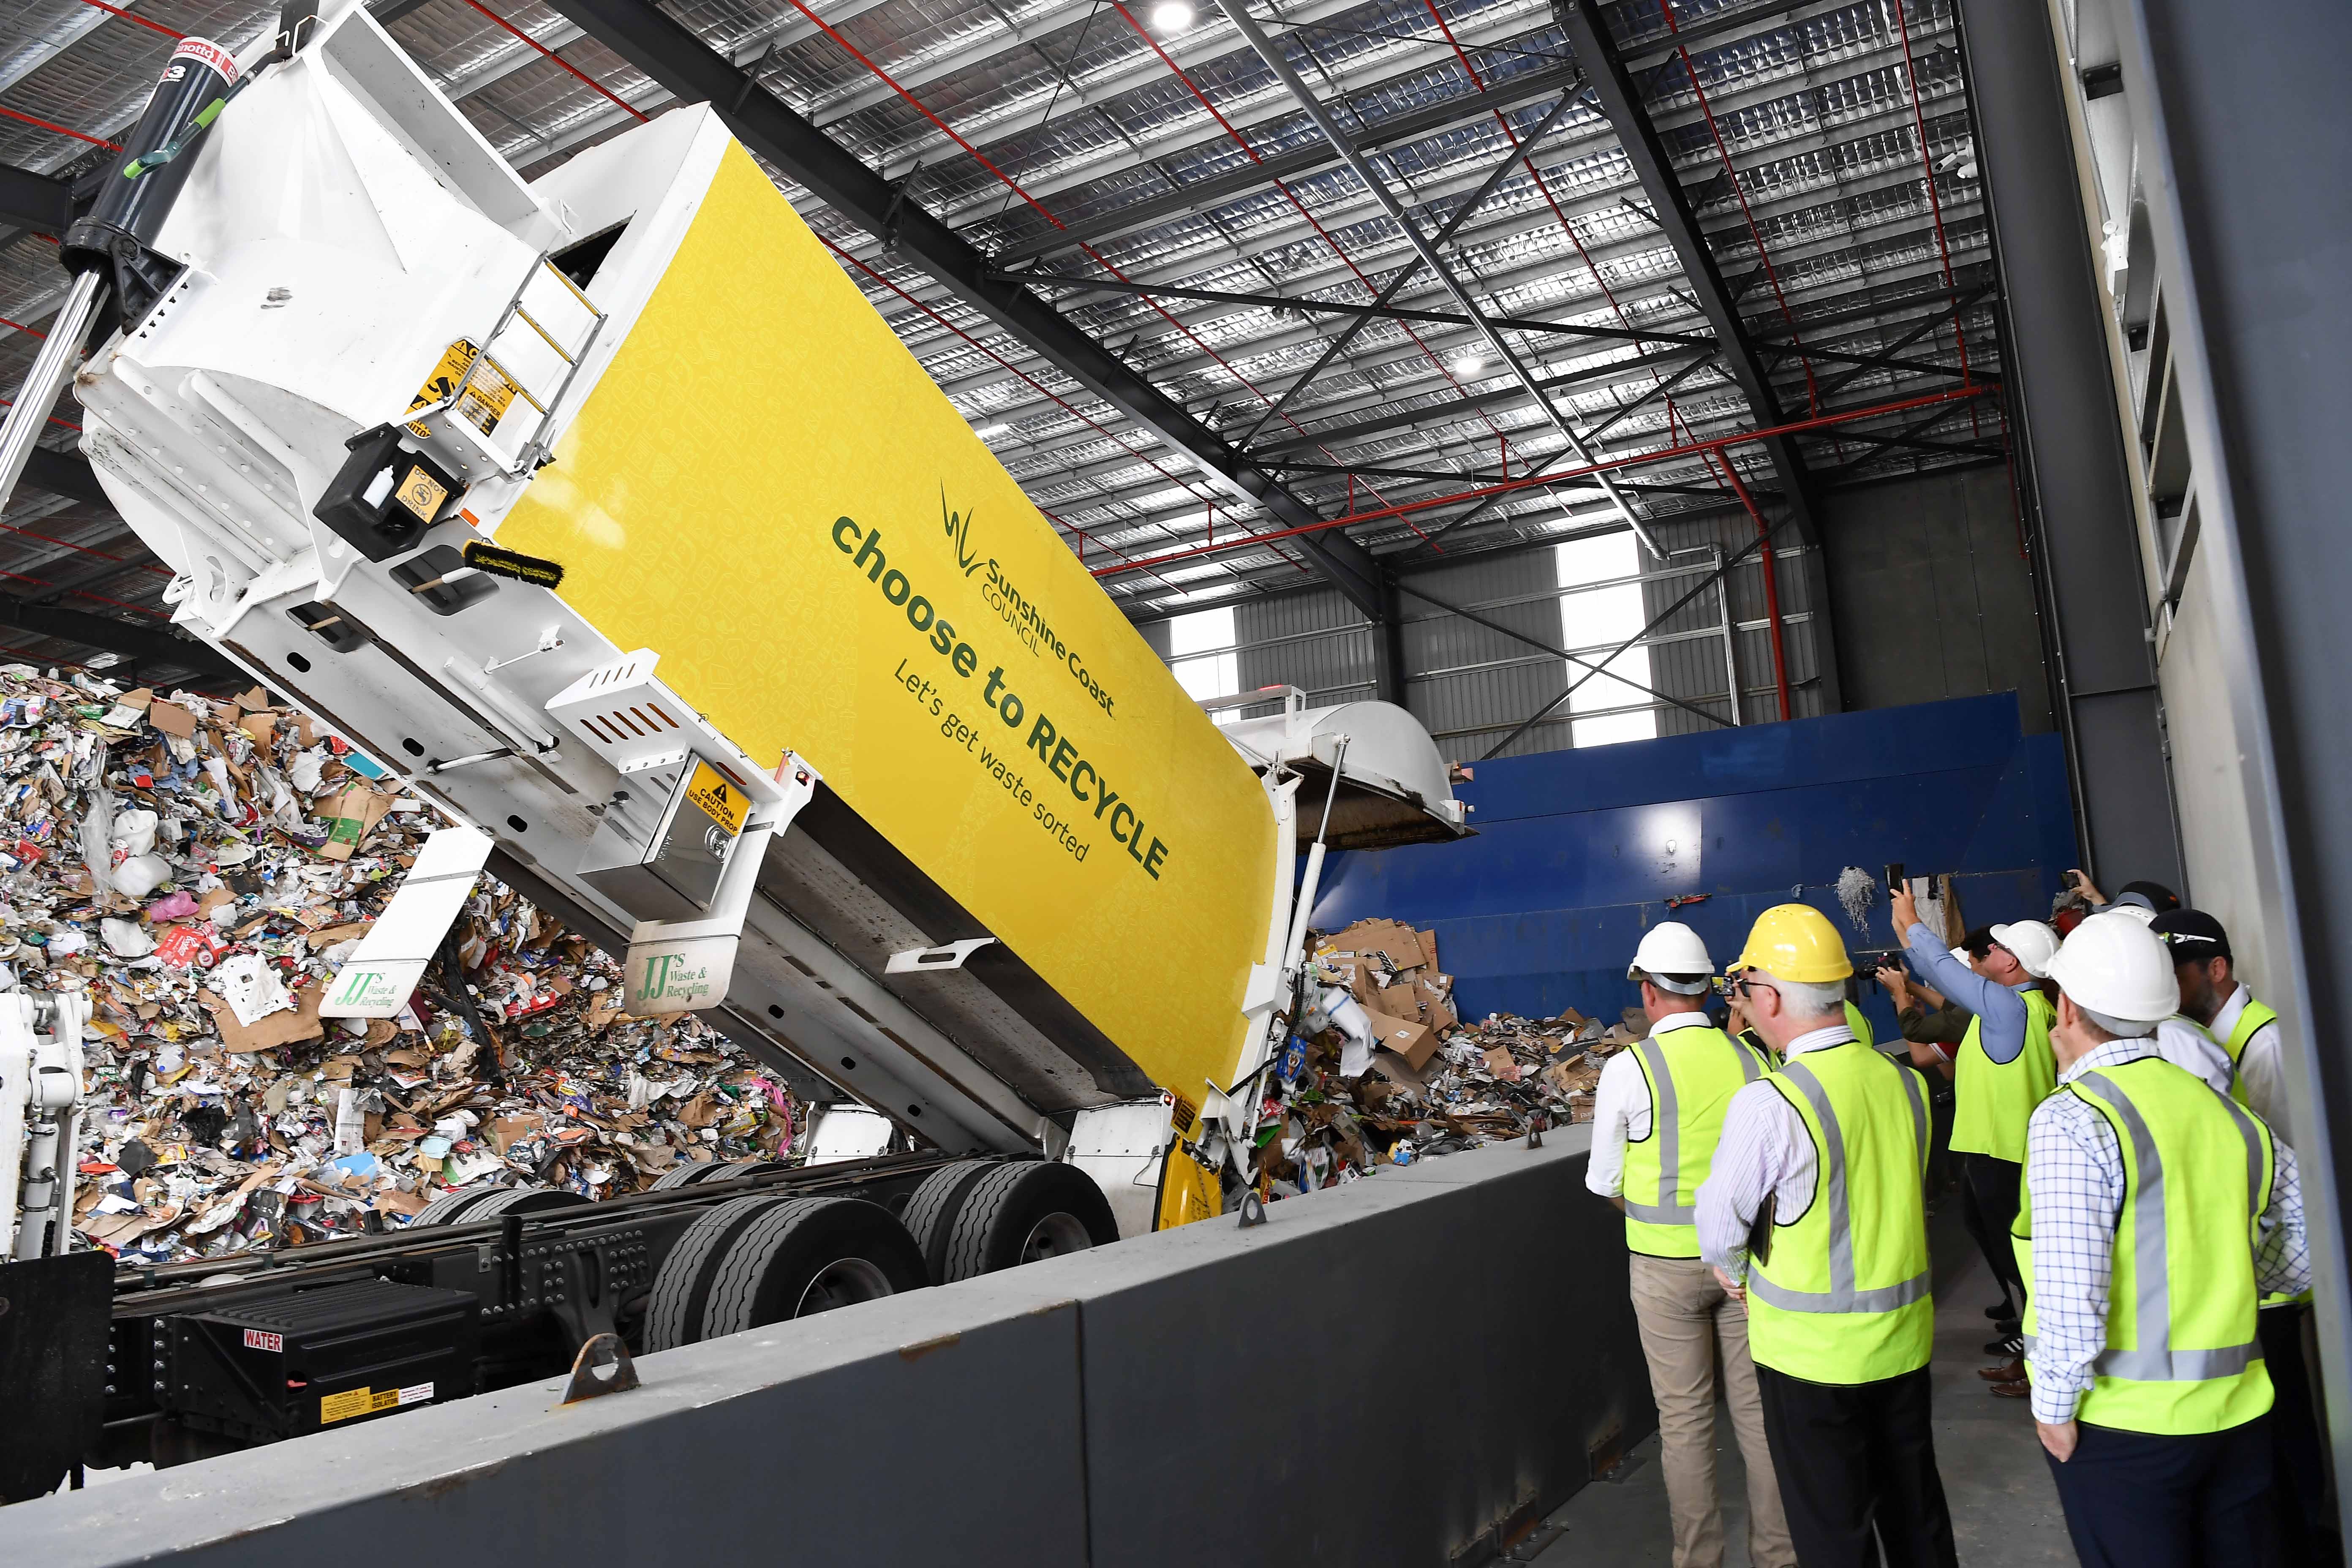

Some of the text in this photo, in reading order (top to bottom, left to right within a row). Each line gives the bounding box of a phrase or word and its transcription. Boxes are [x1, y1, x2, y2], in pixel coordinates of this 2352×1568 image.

[477, 395, 501, 418] DANGER
[415, 468, 446, 495] DO NOT
[401, 495, 427, 518] DRINK
[983, 583, 1039, 658] COUNCIL
[986, 558, 1114, 718] Sunshine Coast
[832, 516, 1169, 882] choose to RECYCLE
[894, 658, 1090, 863] Let's get waste sorted
[689, 789, 738, 832] USE BODY PROP
[700, 788, 735, 820] CAUTION
[670, 966, 707, 981] Waste &
[389, 985, 397, 994] &
[666, 982, 709, 997] Recycling
[246, 1330, 281, 1351] WATER
[372, 1391, 397, 1402] BATTERY
[372, 1397, 399, 1409] ISOLATOR
